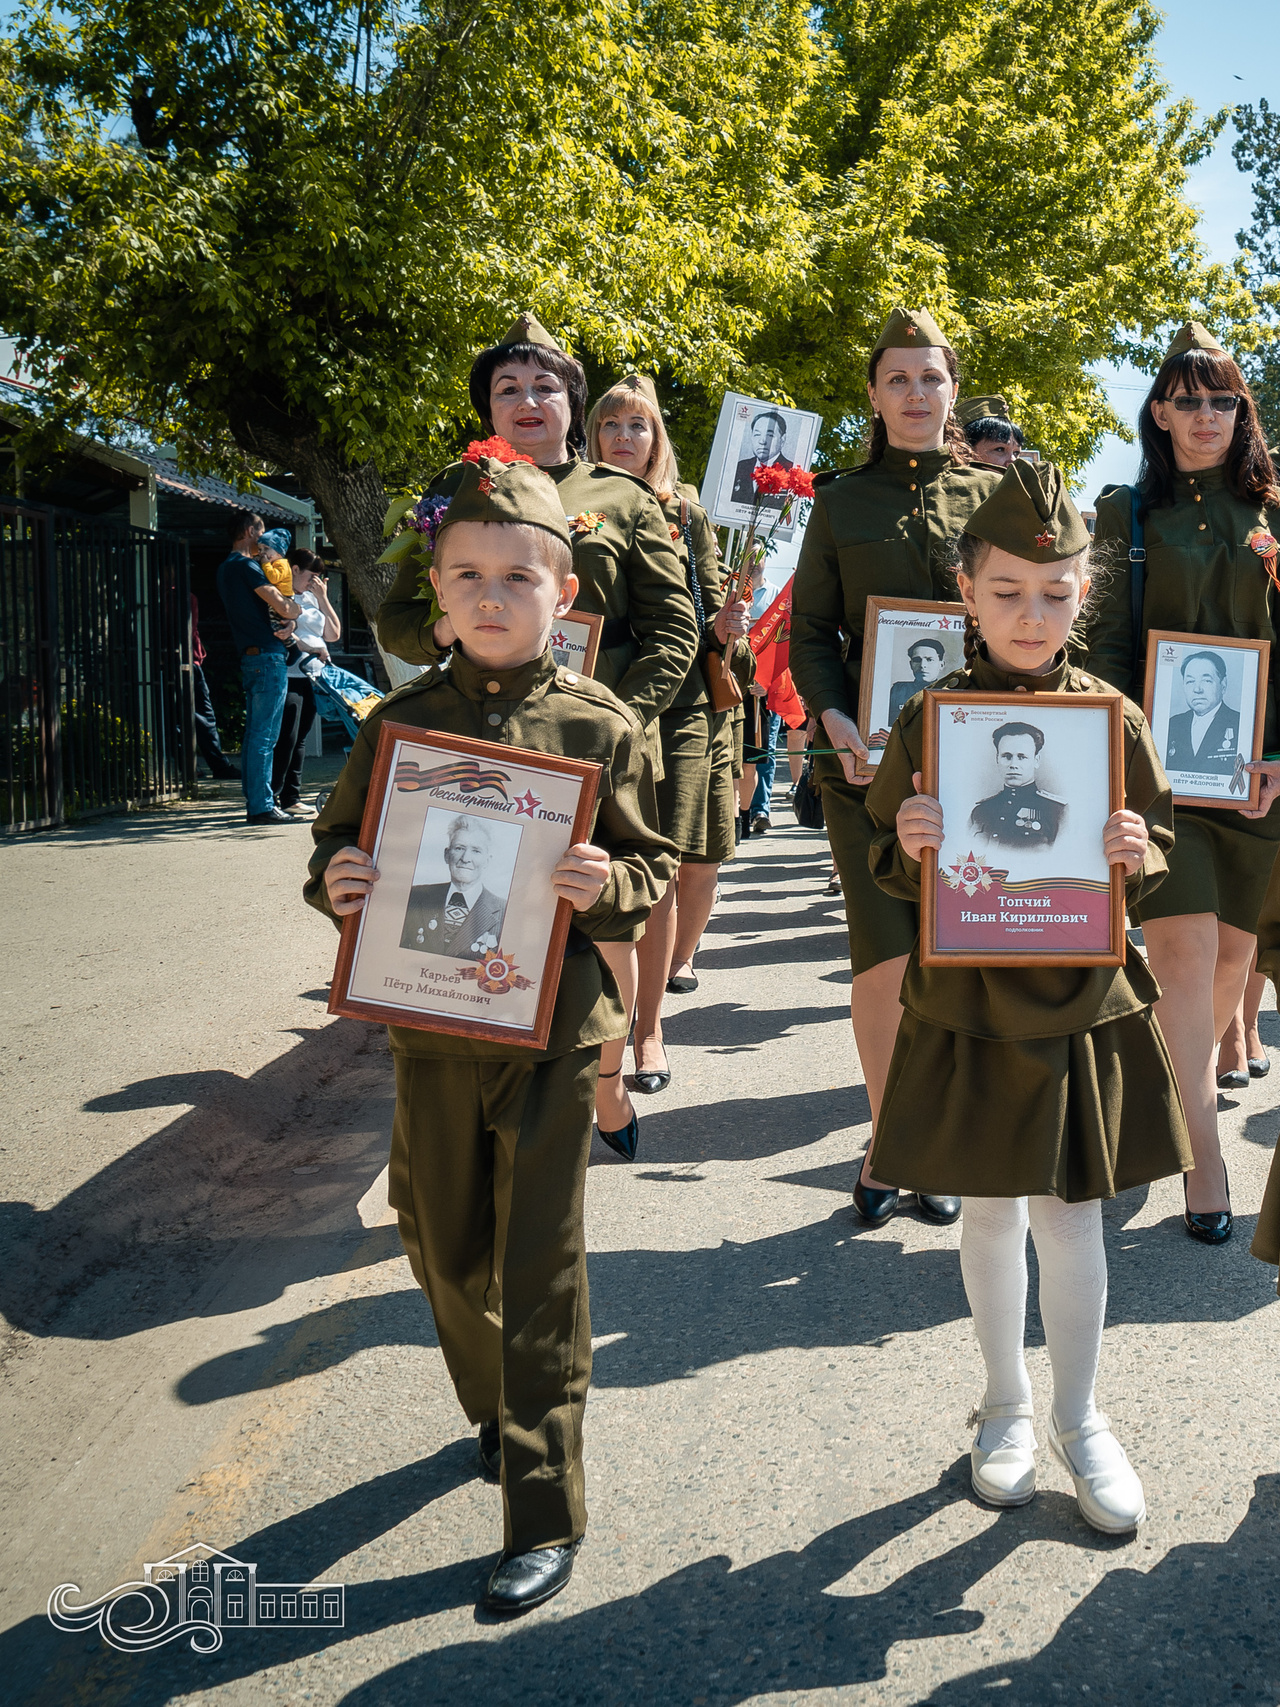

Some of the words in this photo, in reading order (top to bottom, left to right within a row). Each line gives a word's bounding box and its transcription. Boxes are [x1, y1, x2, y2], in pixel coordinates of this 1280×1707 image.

[1180, 773, 1219, 781] ОЛЬХОВСКИЙ
[998, 895, 1052, 908] Топчий
[960, 911, 997, 923] Иван
[999, 911, 1088, 926] Кириллович
[419, 967, 461, 985] Карьев
[383, 976, 413, 993] Пётр
[416, 982, 492, 1005] Михайлович
